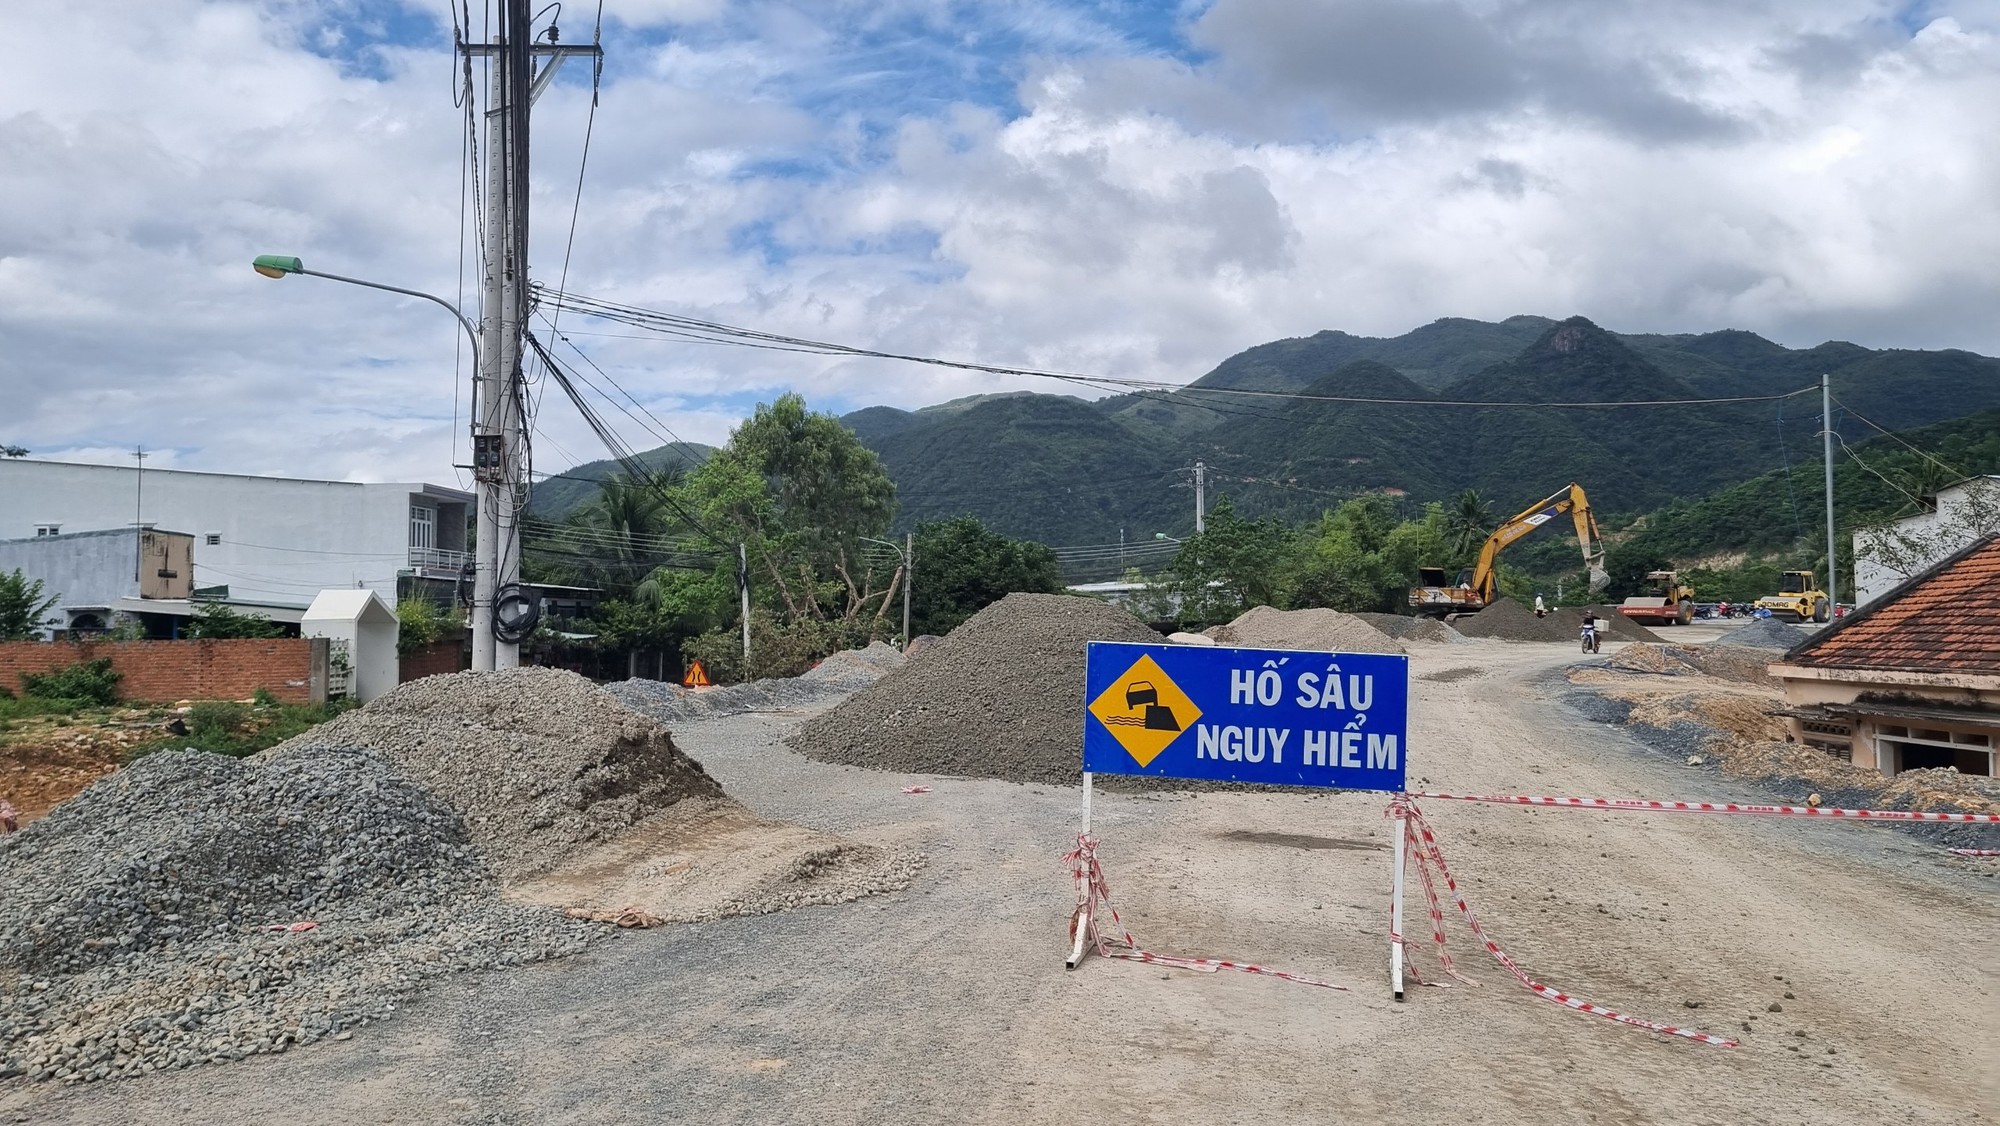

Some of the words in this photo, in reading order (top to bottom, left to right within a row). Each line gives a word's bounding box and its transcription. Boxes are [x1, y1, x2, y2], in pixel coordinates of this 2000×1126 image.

[1230, 657, 1290, 707] HỐ
[1296, 664, 1374, 711] SÂU
[1196, 724, 1290, 764] NGUY
[1303, 713, 1398, 770] HIỂM
